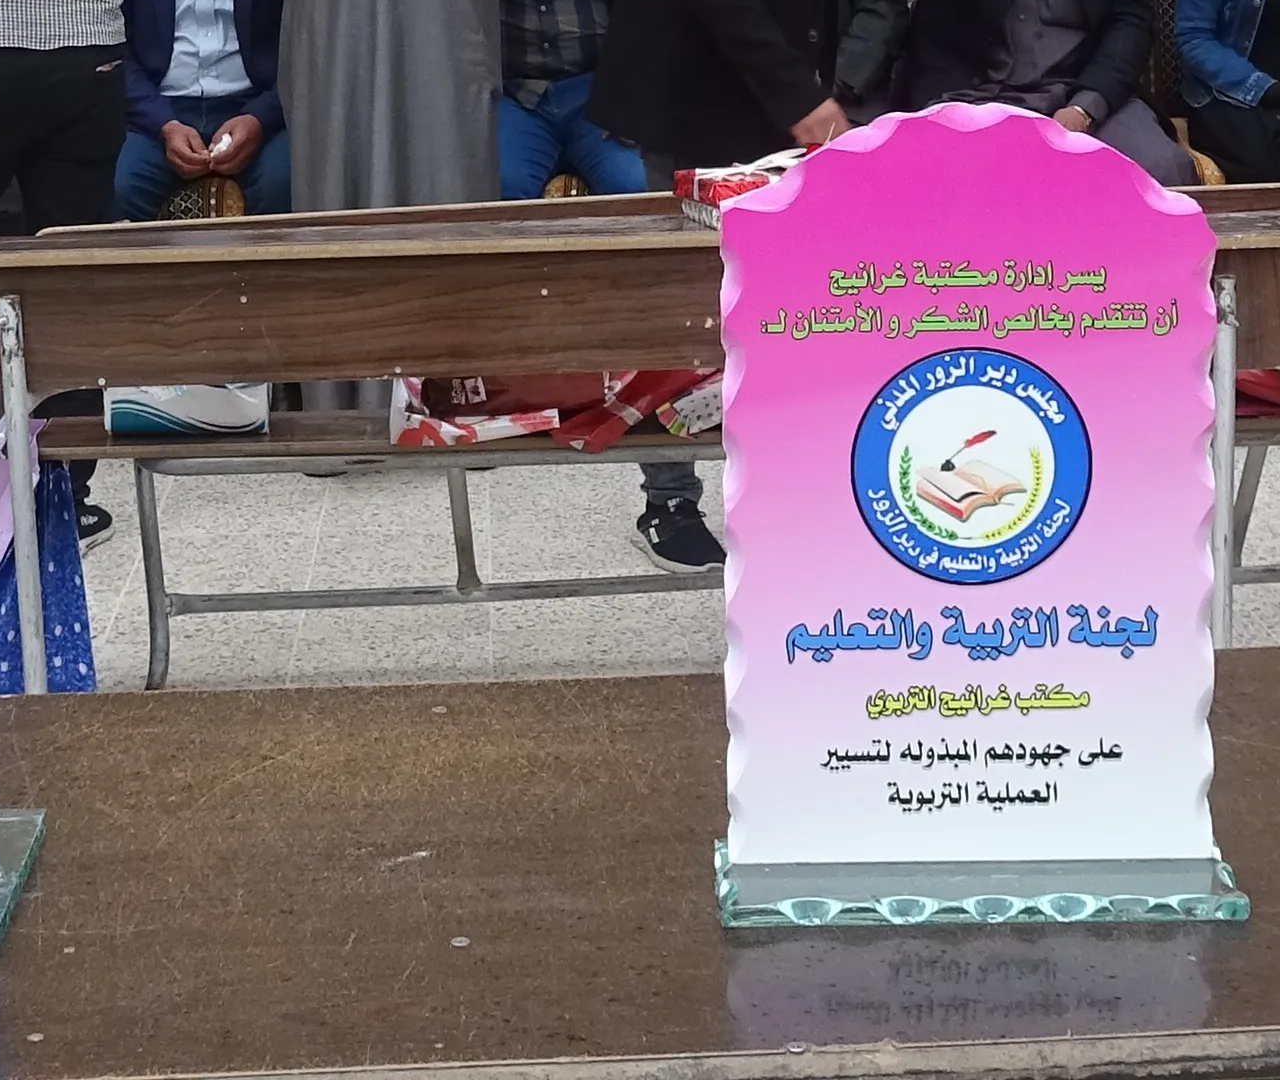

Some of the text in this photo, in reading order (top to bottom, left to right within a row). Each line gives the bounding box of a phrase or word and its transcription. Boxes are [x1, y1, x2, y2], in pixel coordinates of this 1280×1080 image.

[828, 259, 1107, 297] يسر إدارة مكتبة غرانيج
[791, 301, 883, 340] الأمتنان
[884, 314, 901, 339] و
[902, 301, 988, 339] الشكر
[992, 303, 1075, 339] بخالص
[1080, 302, 1149, 338] تتقدم
[1152, 298, 1179, 336] أن
[876, 355, 1066, 431] مجلس دير الزور المدني
[867, 488, 1071, 574] لجنة التربية والتعليم في دير الزور
[785, 604, 1160, 664] لجنة التربية والتعليم
[865, 683, 1091, 719] مكتب غرانيج التربوي
[820, 737, 1124, 770] على جهودهم المبذوله لتسيير
[887, 781, 1058, 814] العملية التربوية
